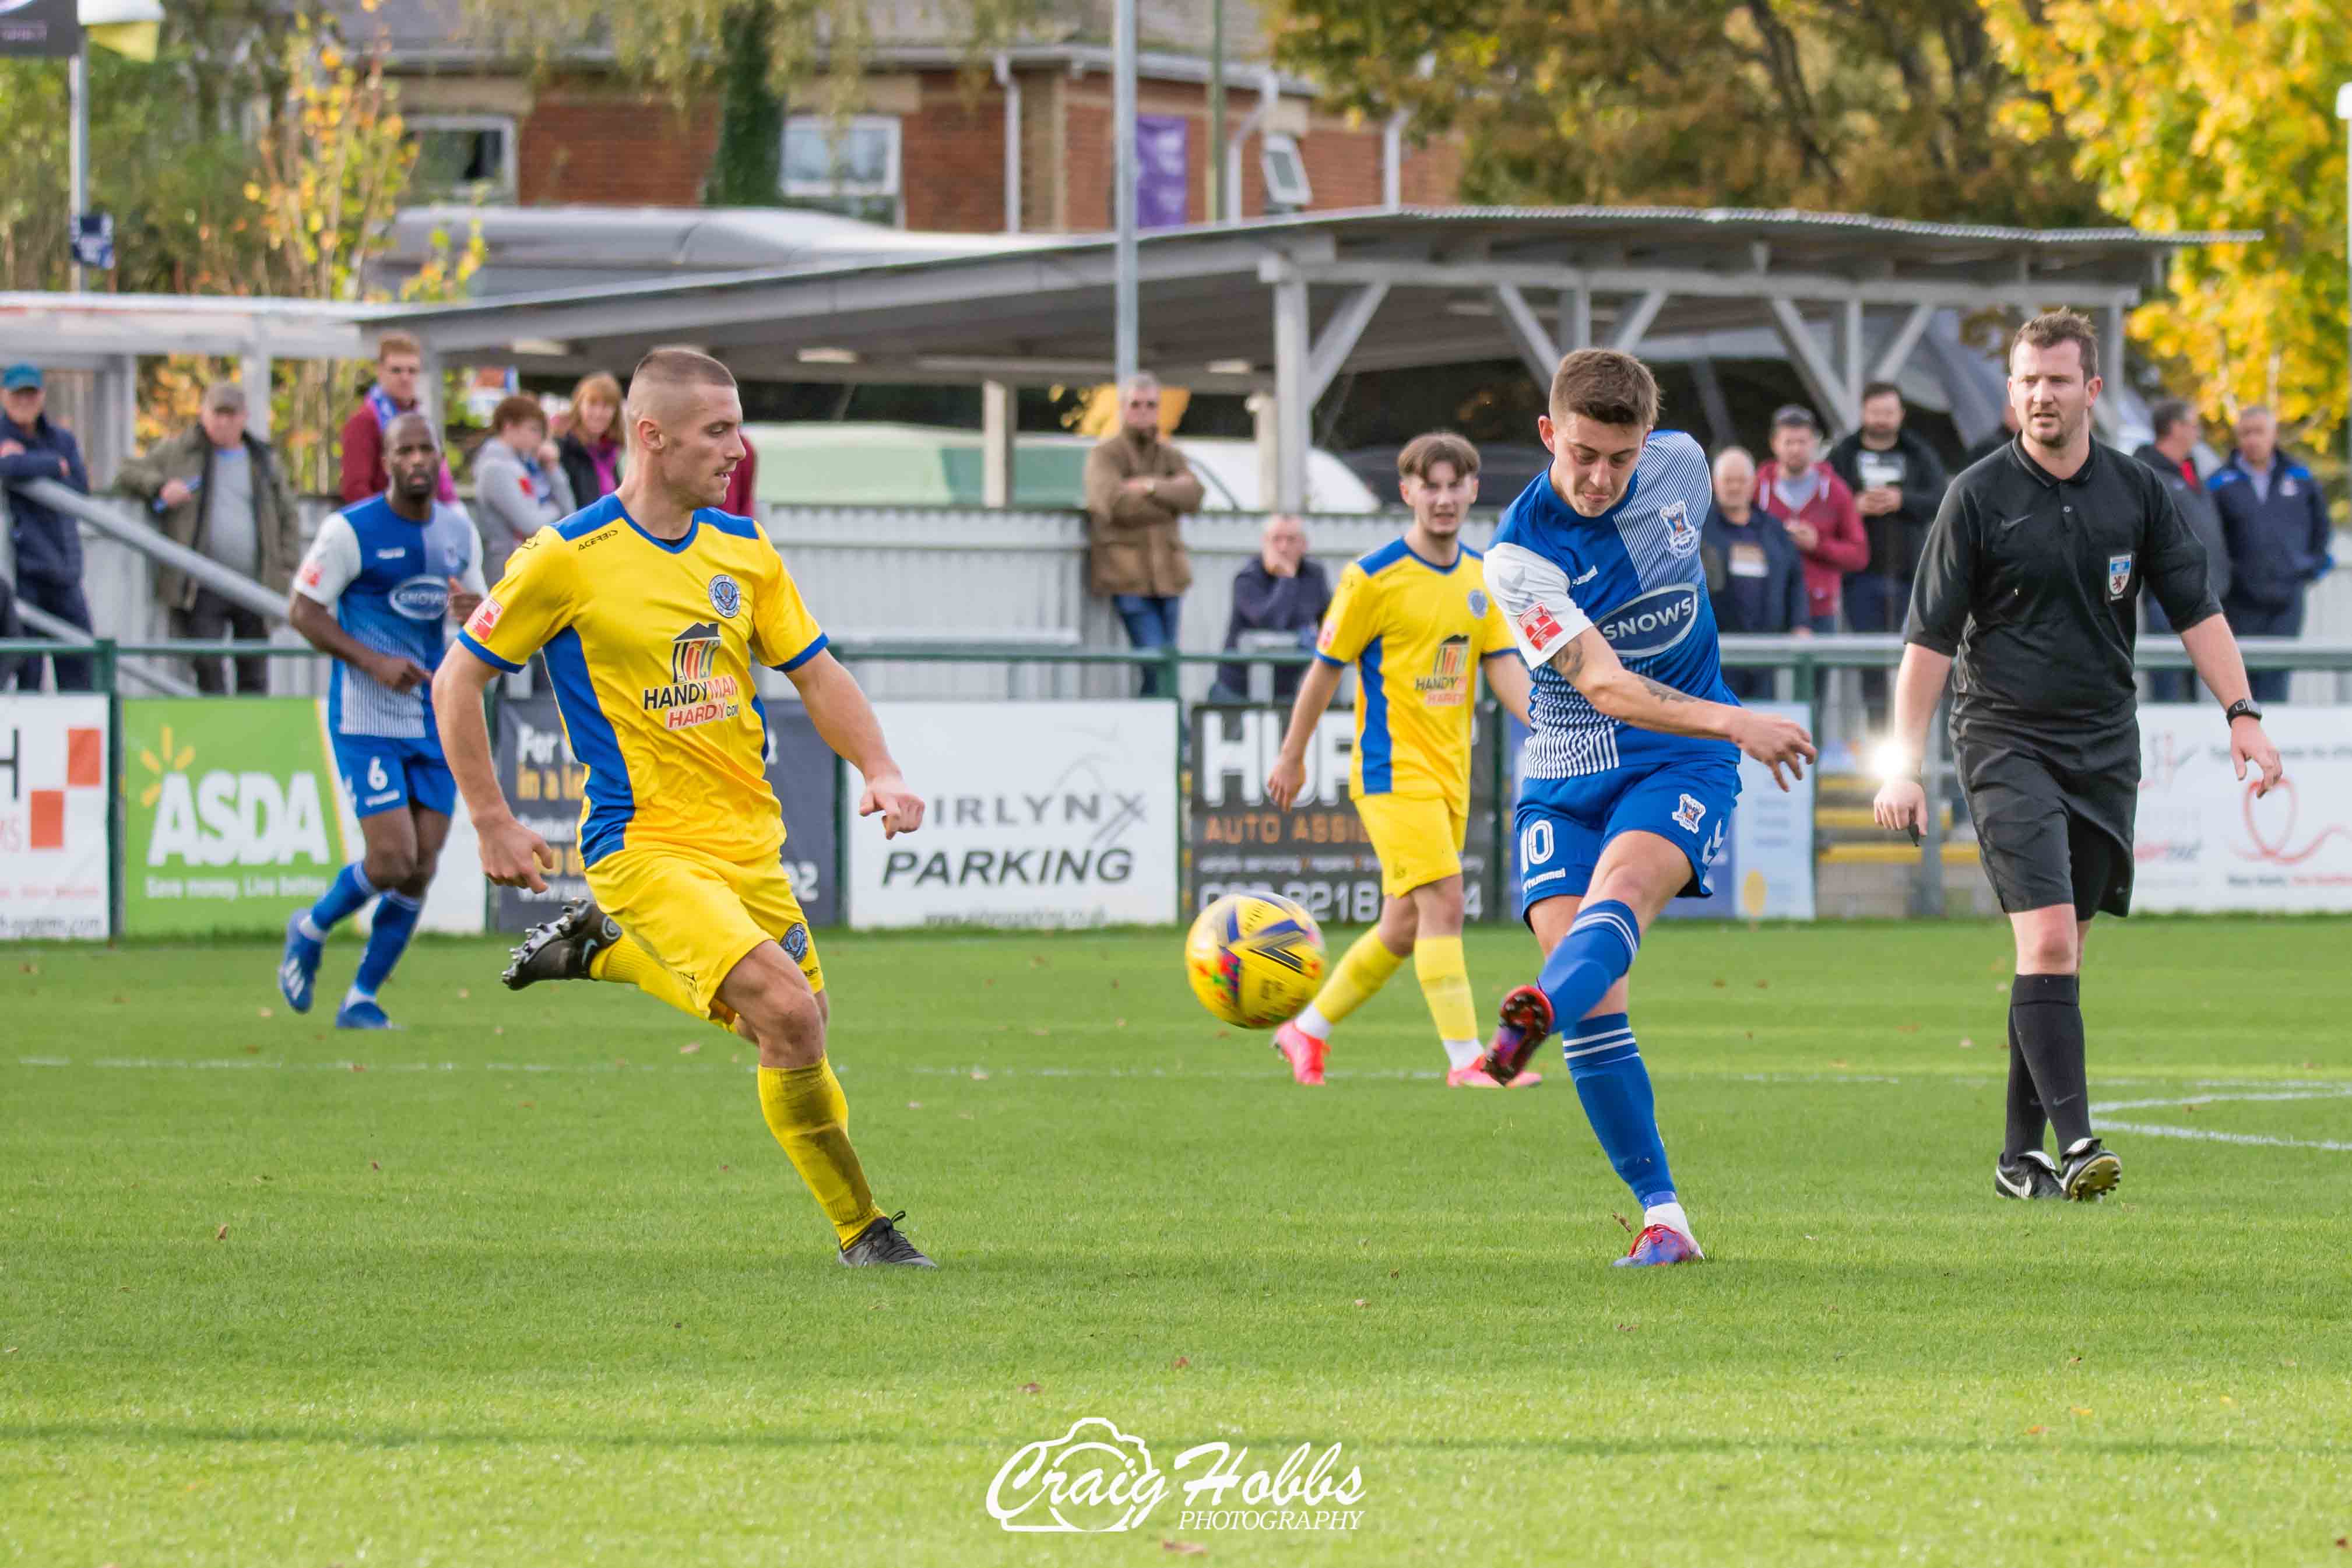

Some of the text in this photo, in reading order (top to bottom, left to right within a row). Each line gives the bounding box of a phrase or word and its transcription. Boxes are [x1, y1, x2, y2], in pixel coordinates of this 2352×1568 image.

[1602, 596, 1692, 641] SNOWS
[367, 756, 388, 791] 6
[147, 770, 331, 867] ASDA
[1204, 813, 1281, 843] AUTO
[1520, 819, 1554, 874] 10
[881, 849, 1135, 887] PARKING
